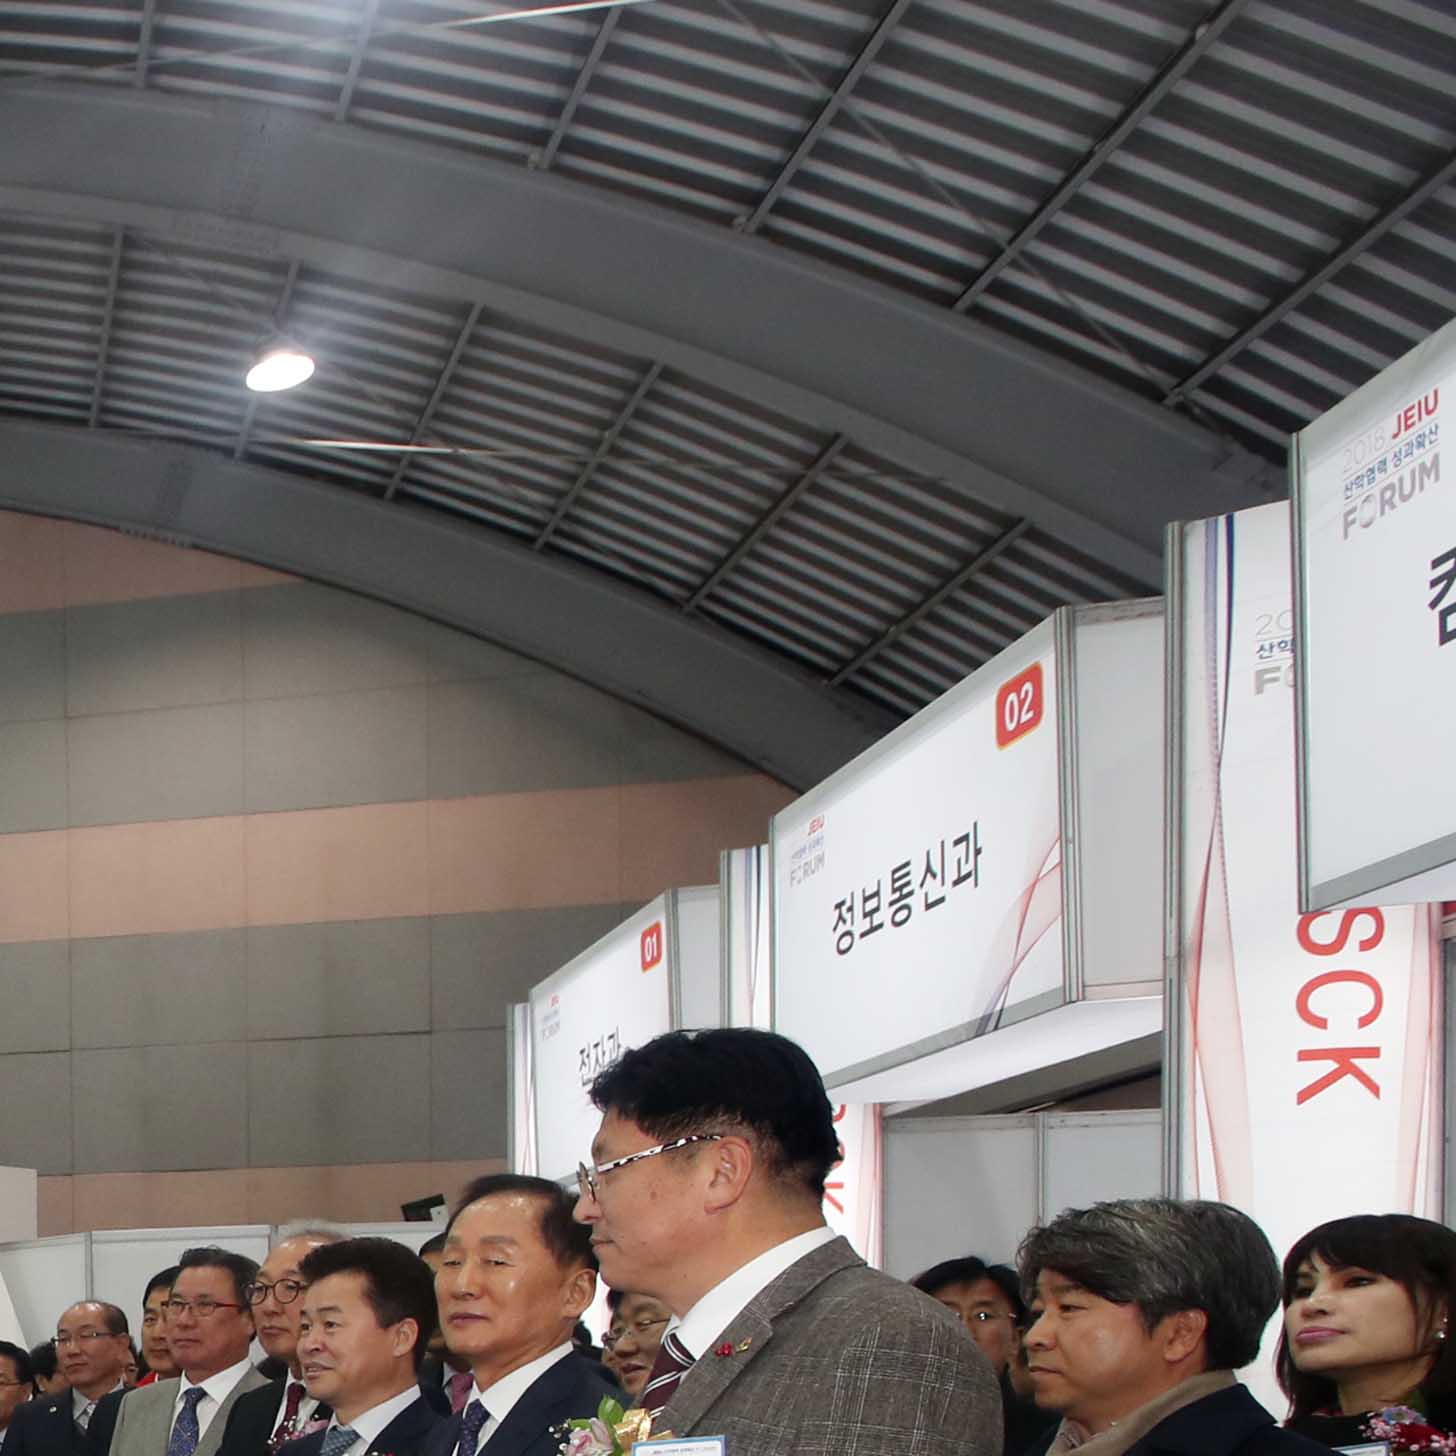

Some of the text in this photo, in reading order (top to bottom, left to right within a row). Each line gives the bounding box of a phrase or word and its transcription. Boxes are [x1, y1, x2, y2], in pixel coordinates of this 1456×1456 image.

[1392, 388, 1439, 440] JEIU
[1343, 424, 1440, 500] 산학협력 성과확산
[1342, 453, 1441, 541] FORUM
[1004, 680, 1035, 732] 02
[832, 820, 983, 956] 정보통신과
[644, 932, 658, 963] 01
